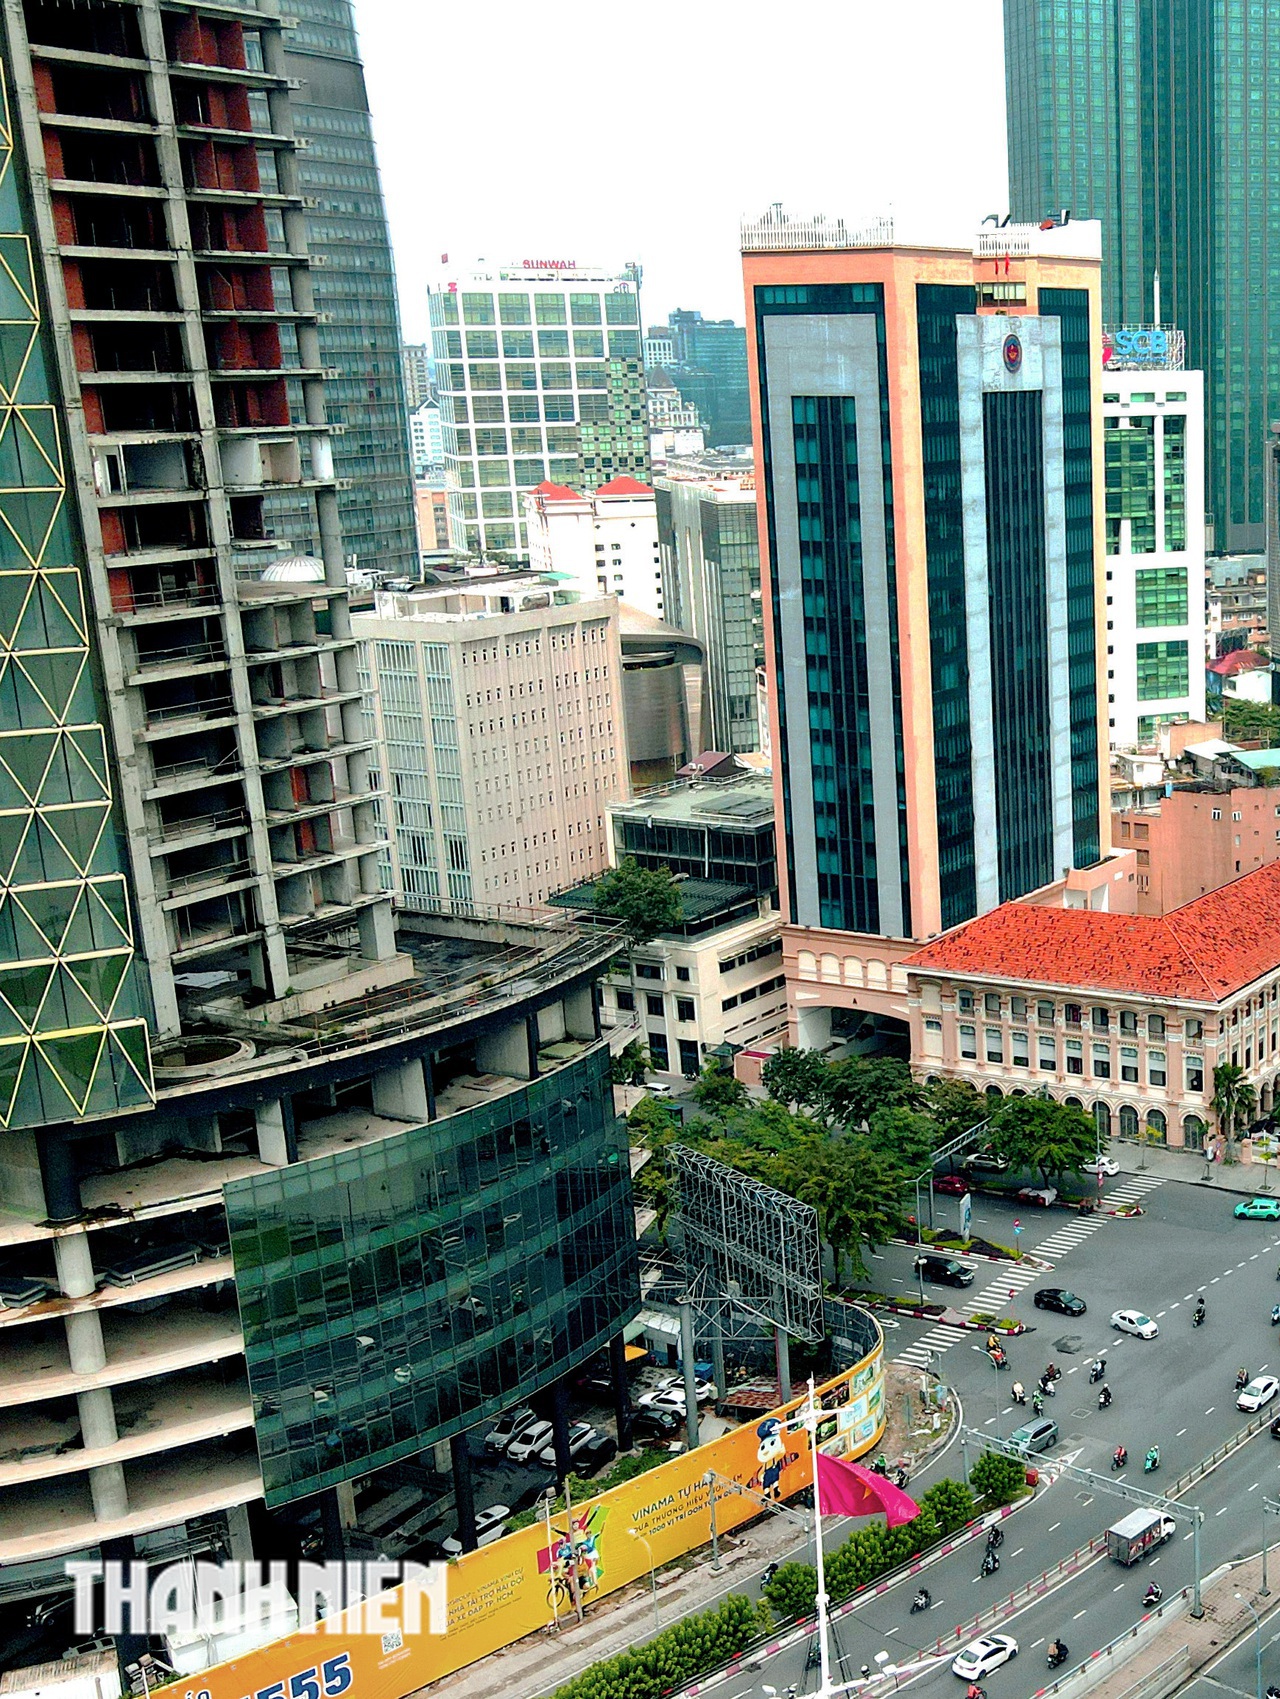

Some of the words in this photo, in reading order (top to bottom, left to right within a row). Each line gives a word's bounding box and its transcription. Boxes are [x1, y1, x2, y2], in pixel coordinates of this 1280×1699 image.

[523, 259, 576, 269] SUNWAH
[1116, 330, 1167, 355] SCB
[632, 1495, 675, 1522] VINAMA
